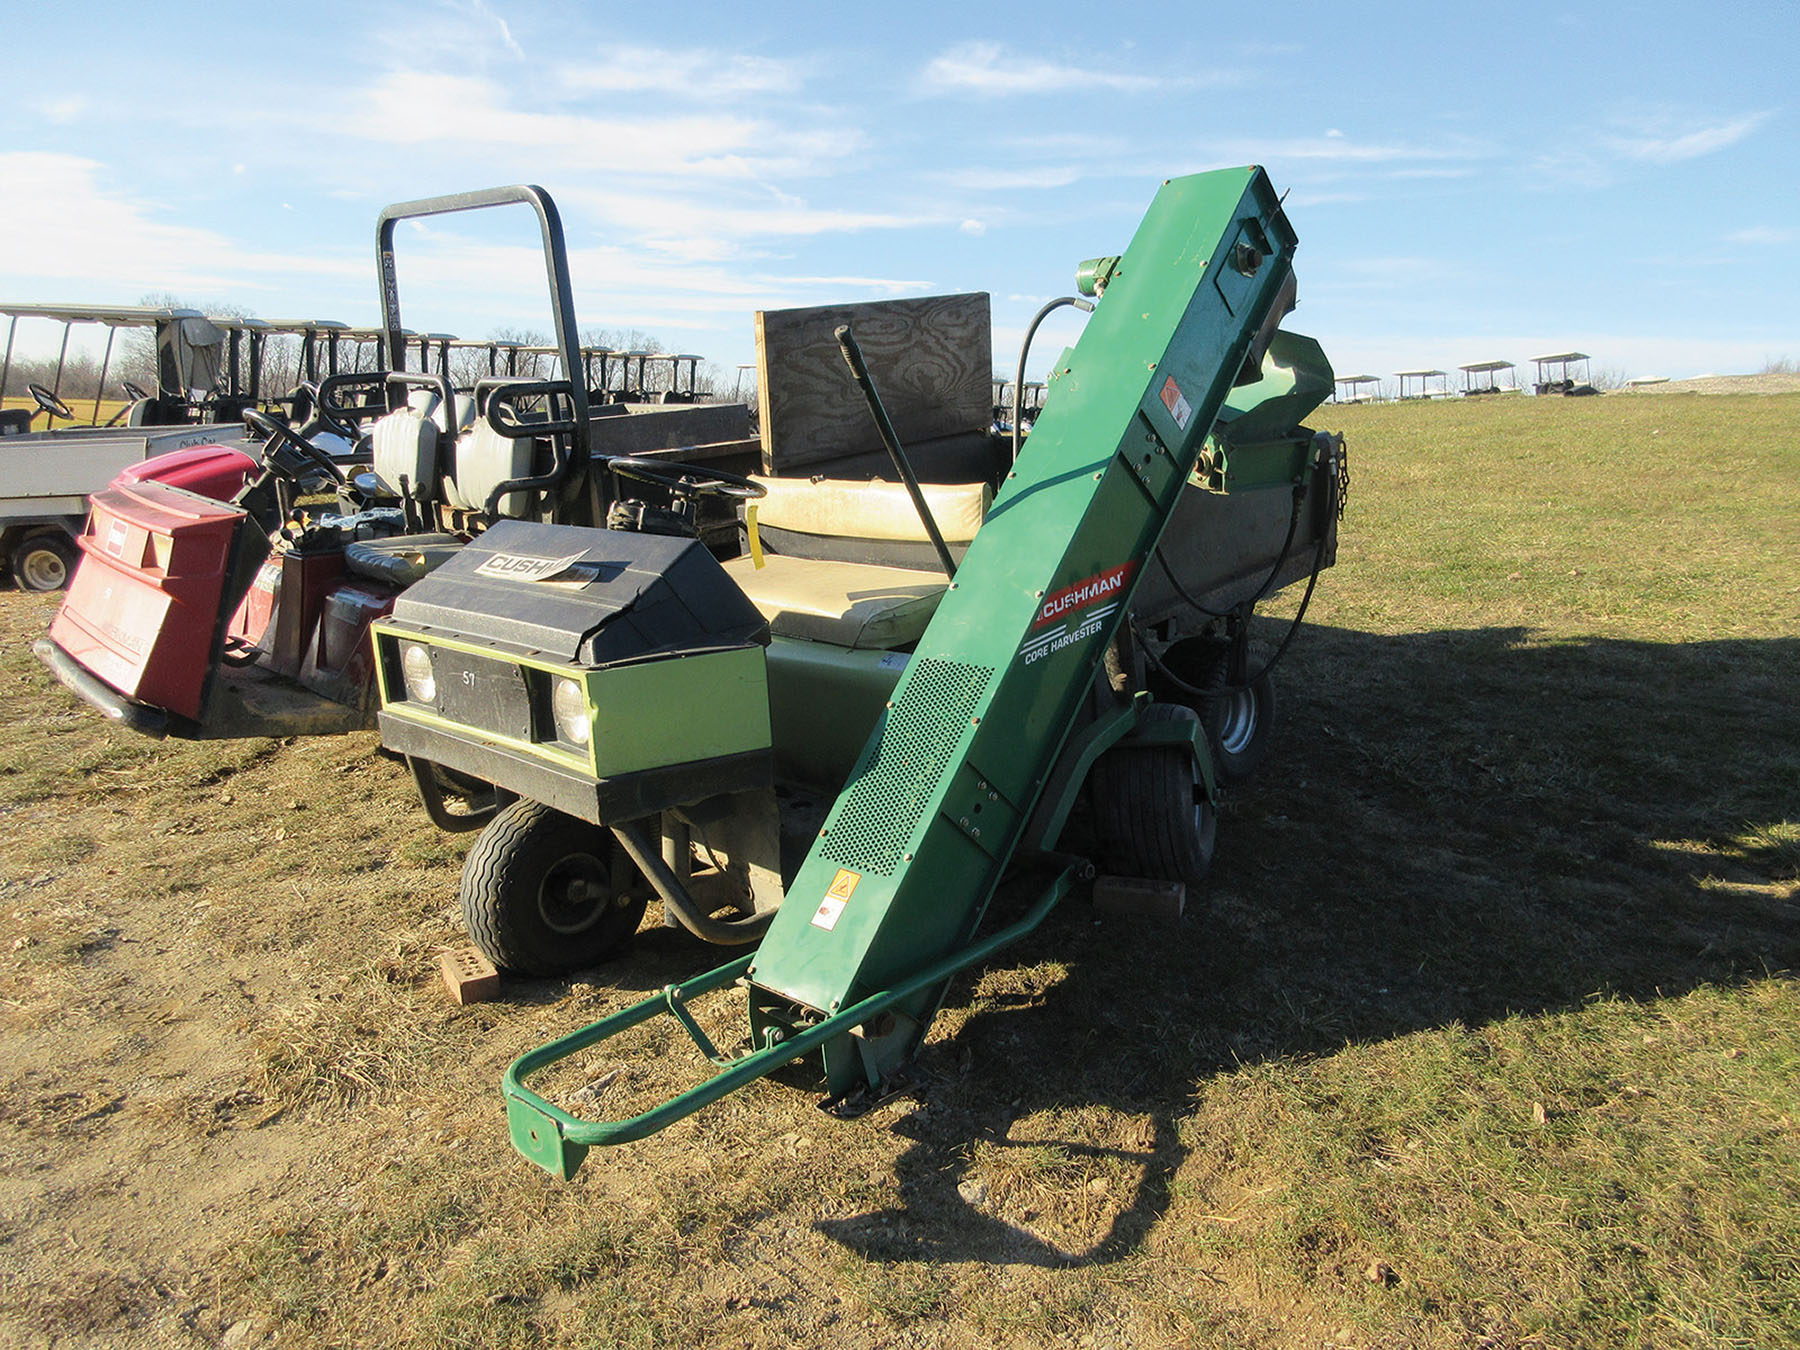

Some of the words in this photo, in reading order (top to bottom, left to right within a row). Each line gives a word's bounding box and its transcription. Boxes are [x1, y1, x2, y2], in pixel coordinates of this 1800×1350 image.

[1043, 575, 1122, 618] CUSHMAN
[1025, 644, 1049, 665] CORE
[1050, 620, 1102, 653] HARVESTER
[462, 670, 475, 688] 57
